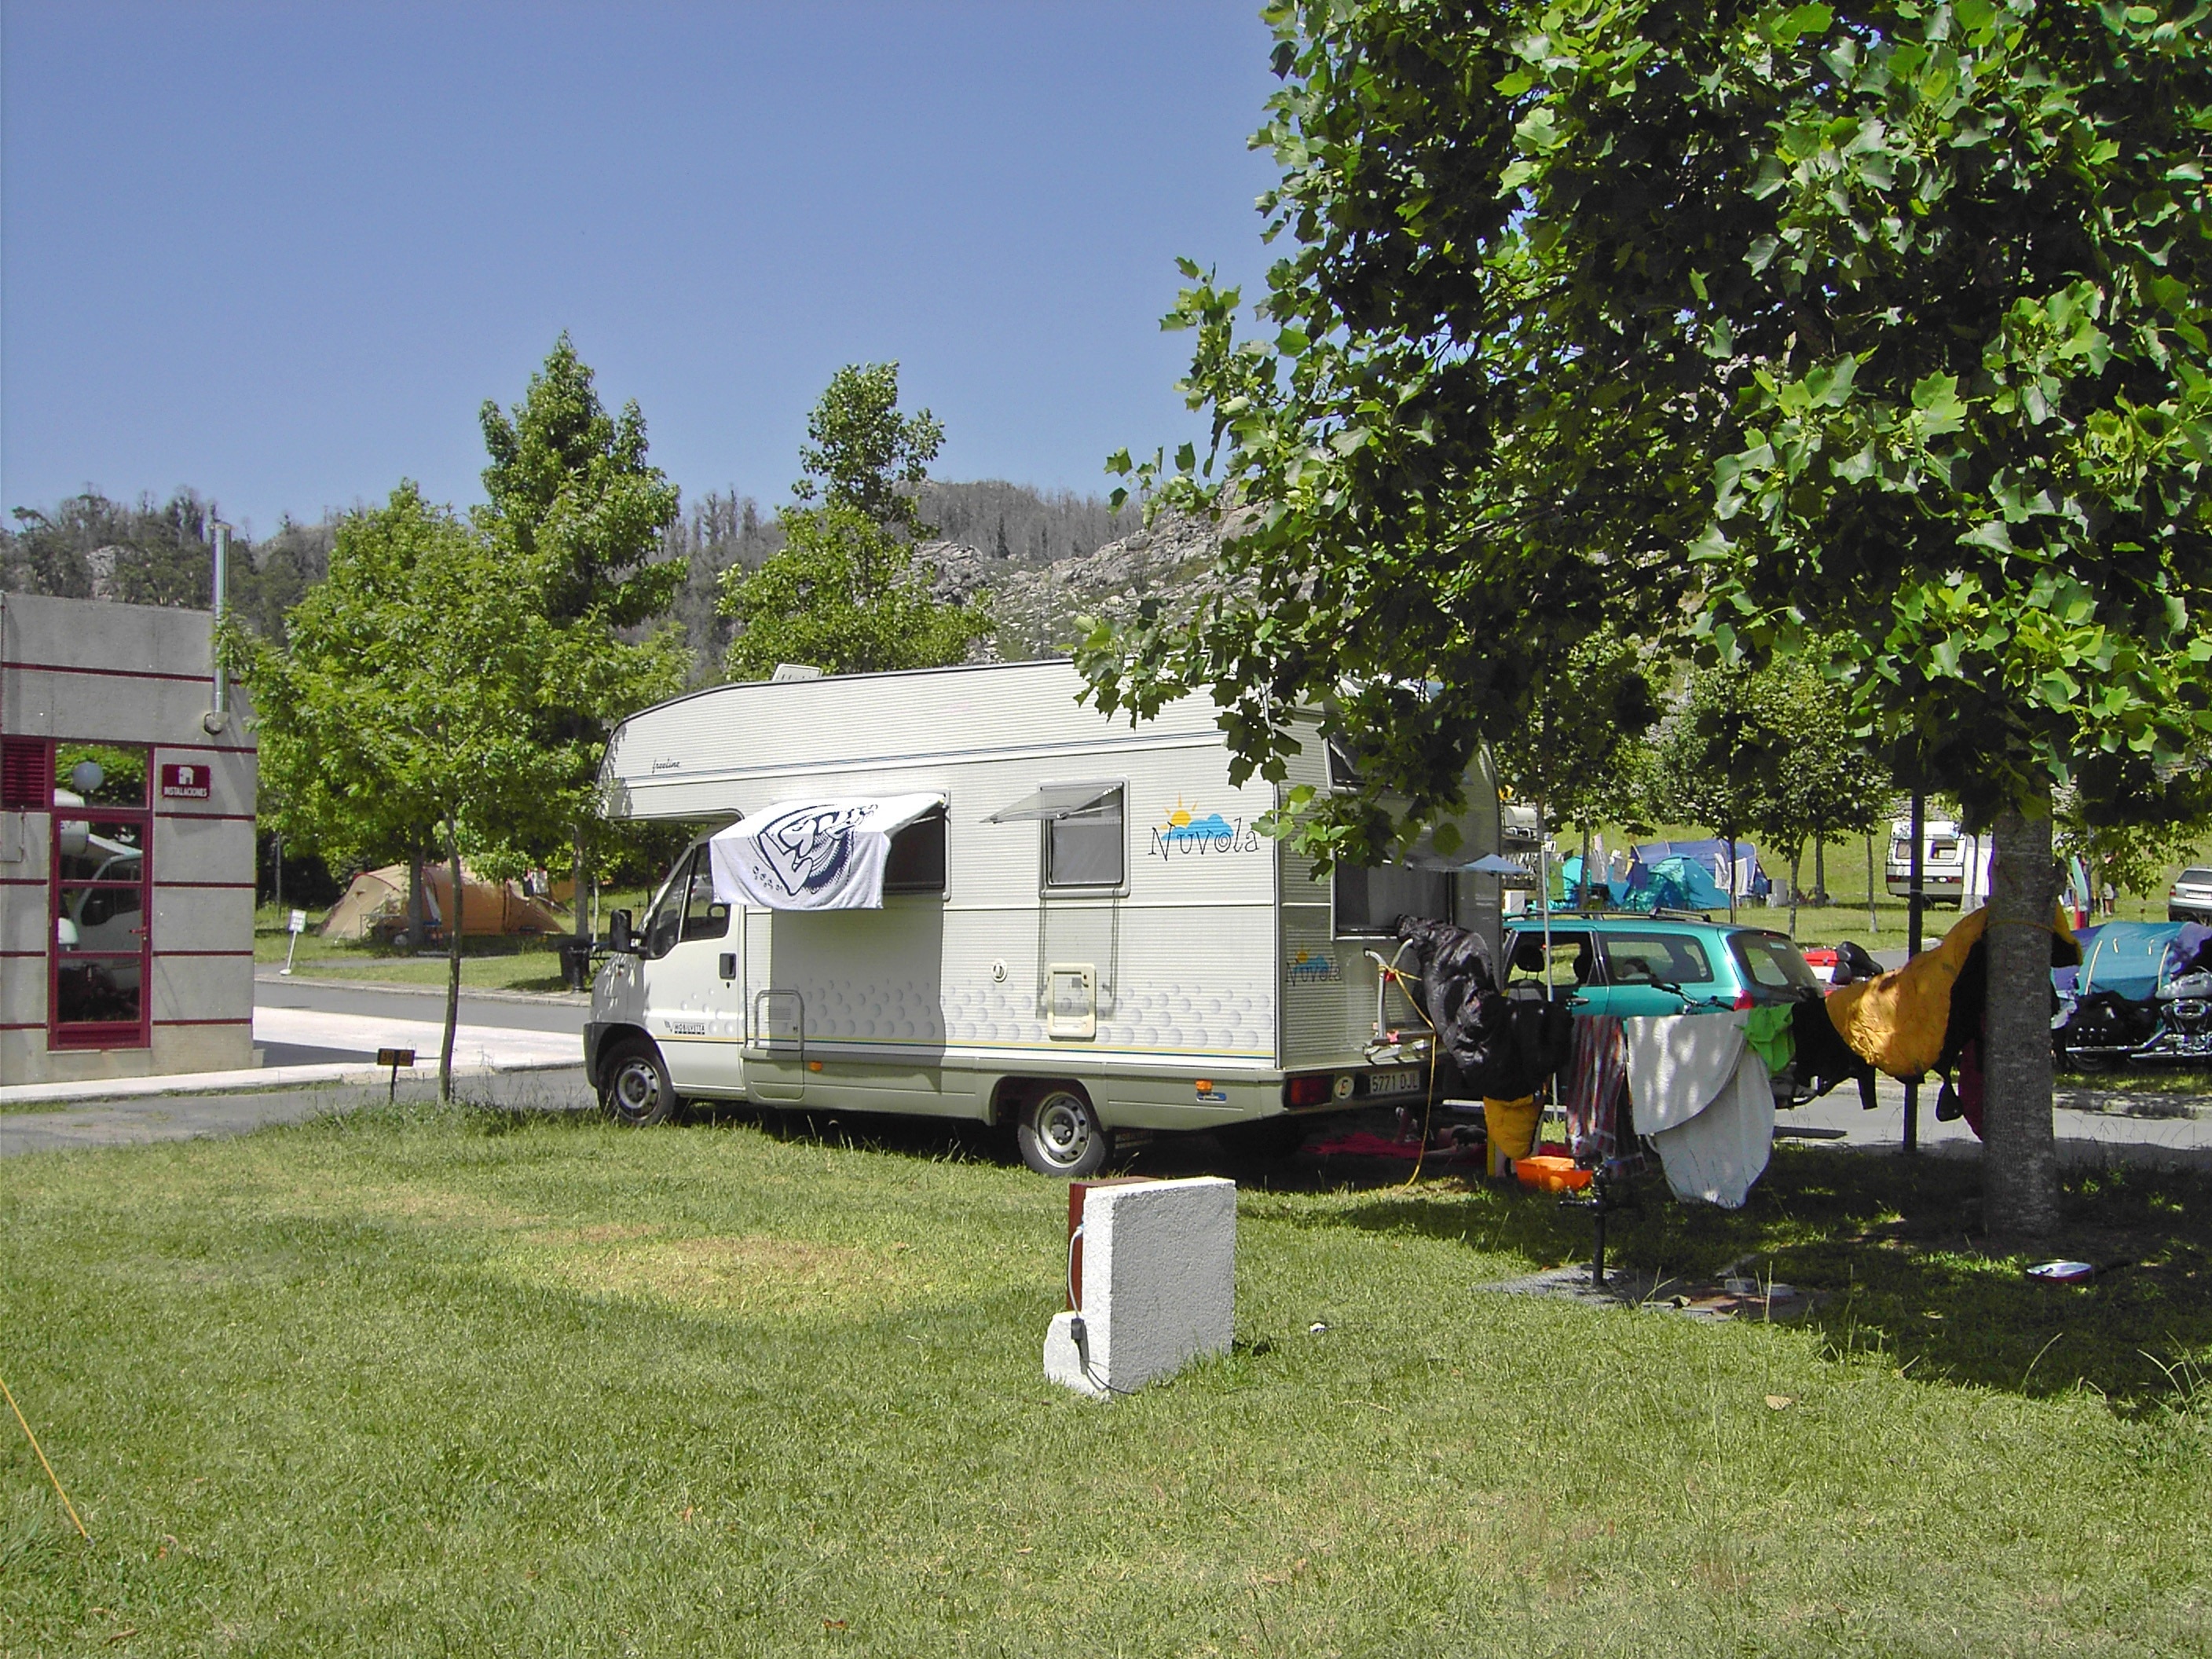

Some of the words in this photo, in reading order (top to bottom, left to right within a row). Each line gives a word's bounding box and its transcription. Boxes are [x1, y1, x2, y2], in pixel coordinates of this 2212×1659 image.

[164, 786, 208, 797] INSTALACIONES
[1148, 817, 1260, 862] Nuvola
[1285, 958, 1342, 987] Nuvola
[1372, 1075, 1396, 1092] 5771
